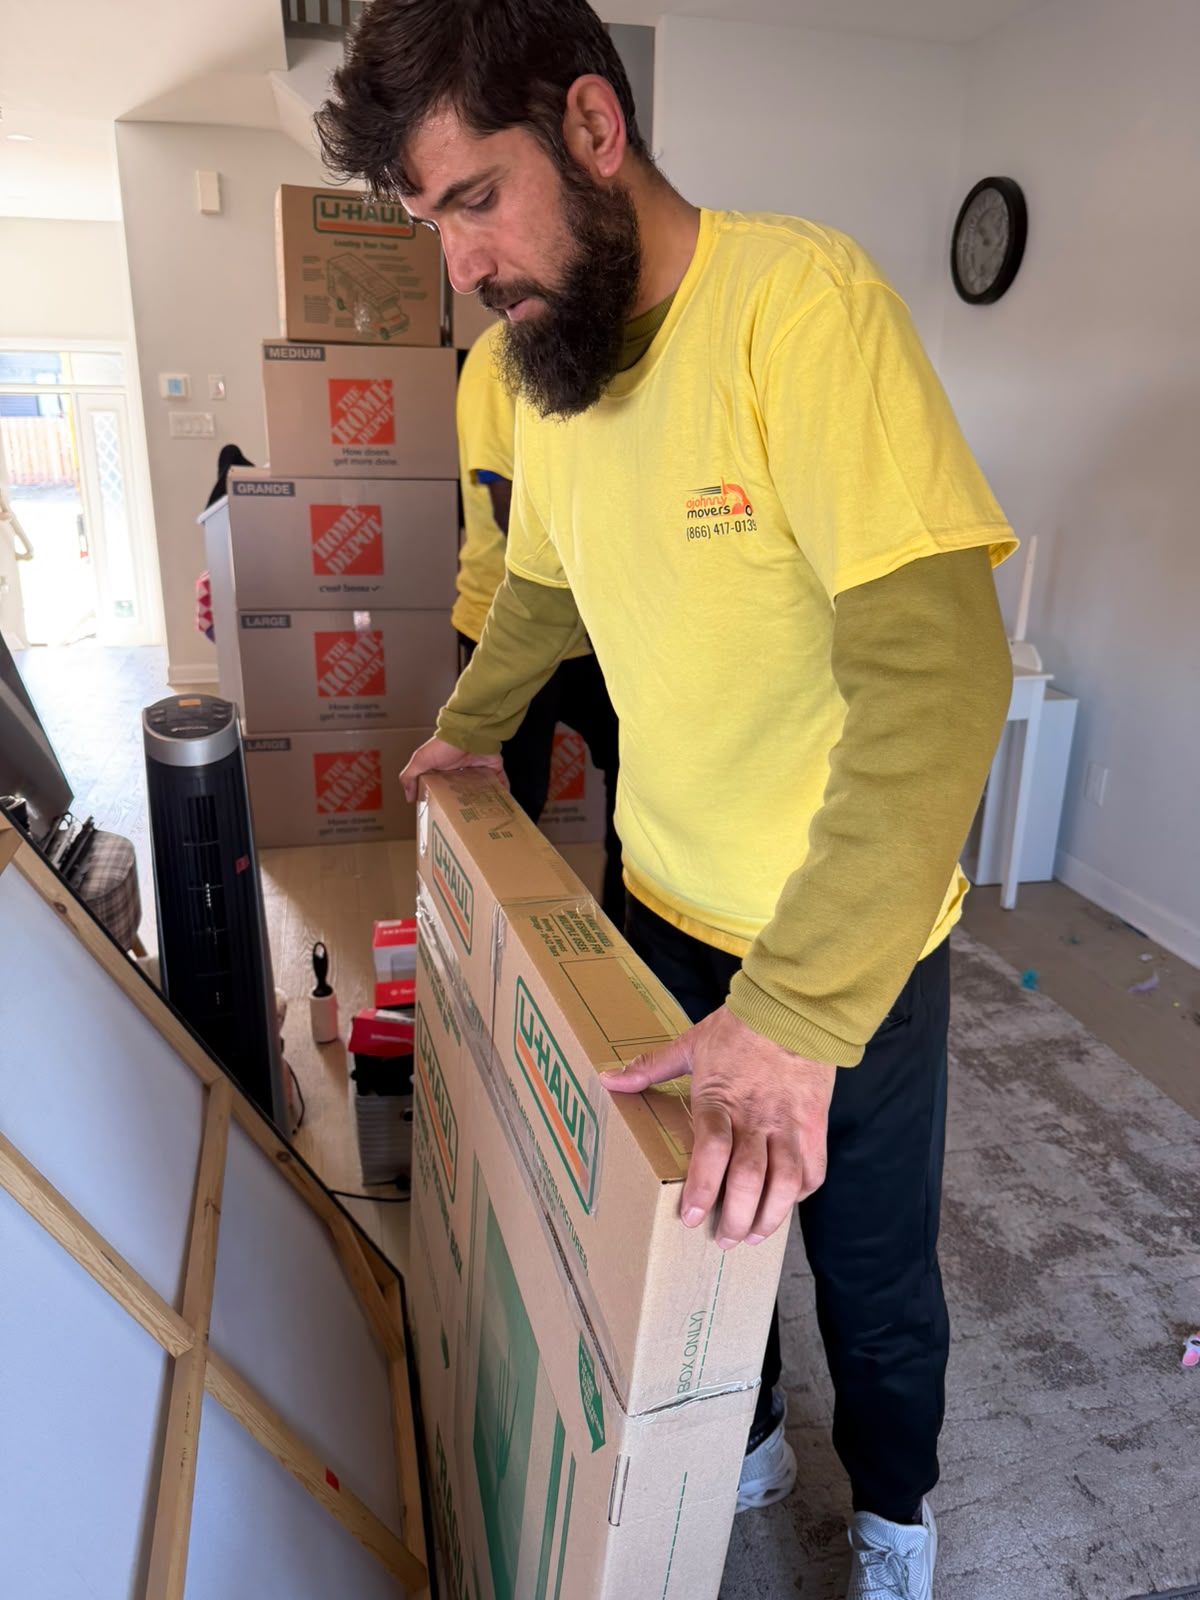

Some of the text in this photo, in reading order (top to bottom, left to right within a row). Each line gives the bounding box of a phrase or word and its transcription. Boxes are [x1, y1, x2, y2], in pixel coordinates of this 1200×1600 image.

[320, 201, 408, 224] U-HAUL
[269, 347, 321, 359] MEDIUM
[330, 379, 394, 445] HOME
[336, 385, 360, 411] THE
[357, 403, 395, 446] DEPOT
[237, 483, 290, 495] GRANDE
[312, 504, 366, 559] HOME
[687, 505, 731, 519] movers
[325, 514, 382, 576] DEPOT
[686, 525, 711, 542] (866)
[245, 617, 287, 627] LARGE
[318, 630, 383, 697] HOME
[323, 638, 350, 665] THE
[345, 655, 385, 696] DEPOT
[318, 750, 379, 813] HOME
[434, 832, 470, 924] U-HAUL
[519, 994, 589, 1169] U-HAUL
[677, 1310, 707, 1393] BOX ONLY)
